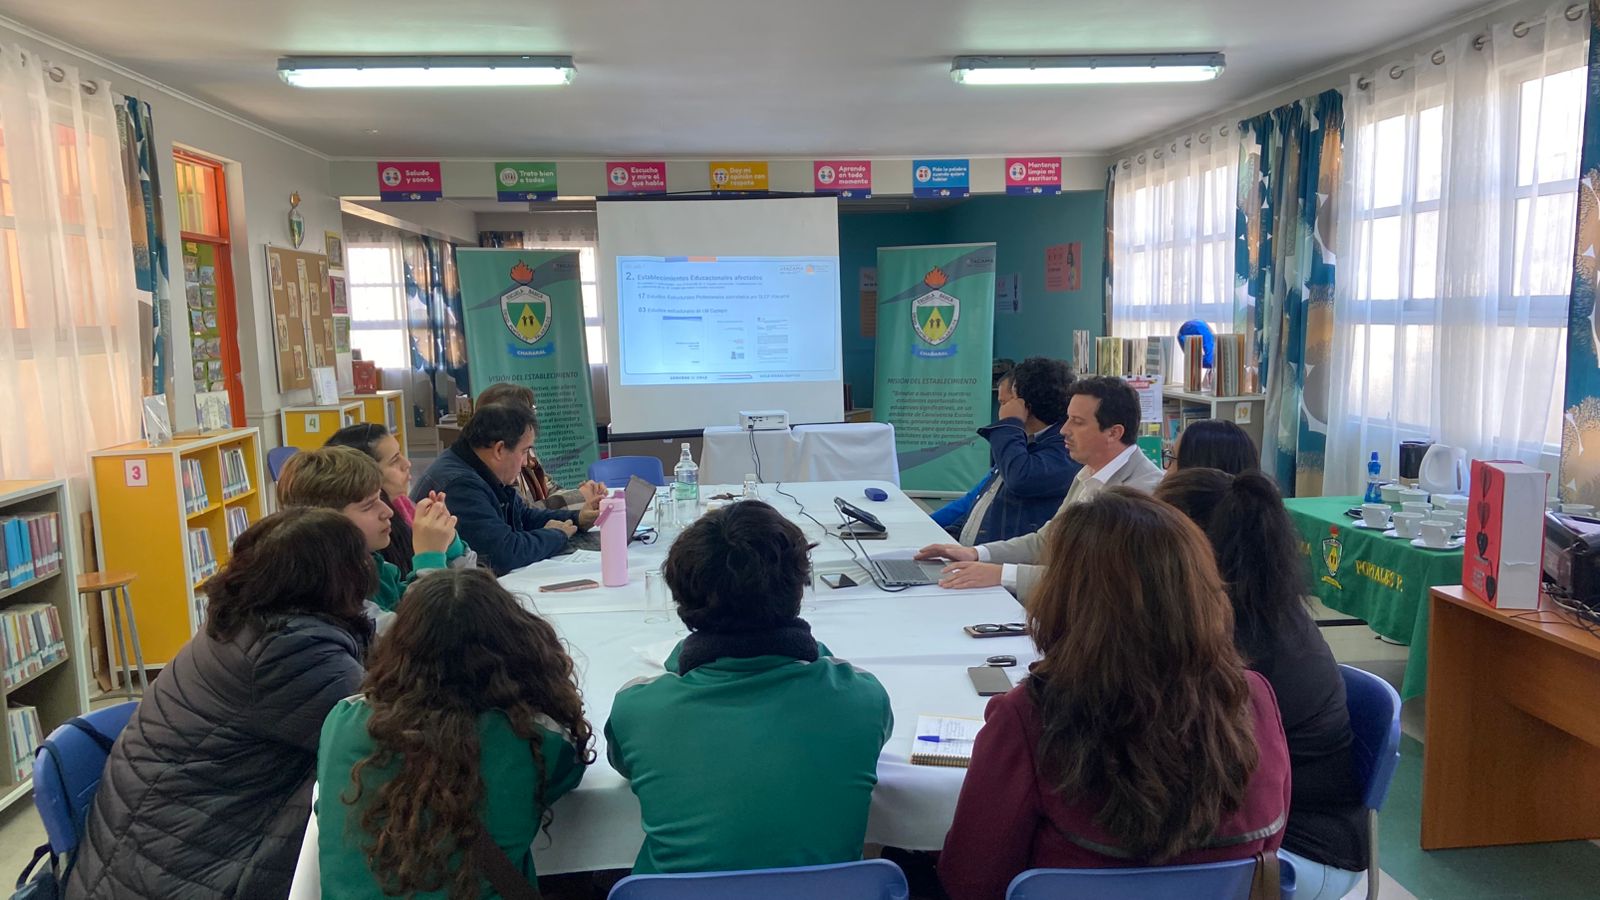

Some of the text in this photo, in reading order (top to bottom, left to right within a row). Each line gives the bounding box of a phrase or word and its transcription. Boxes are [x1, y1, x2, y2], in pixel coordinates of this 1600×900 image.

[524, 372, 579, 381] ESTABLECIMIENTO
[1236, 407, 1249, 419] 19
[309, 418, 316, 429] 4
[131, 466, 142, 480] 3
